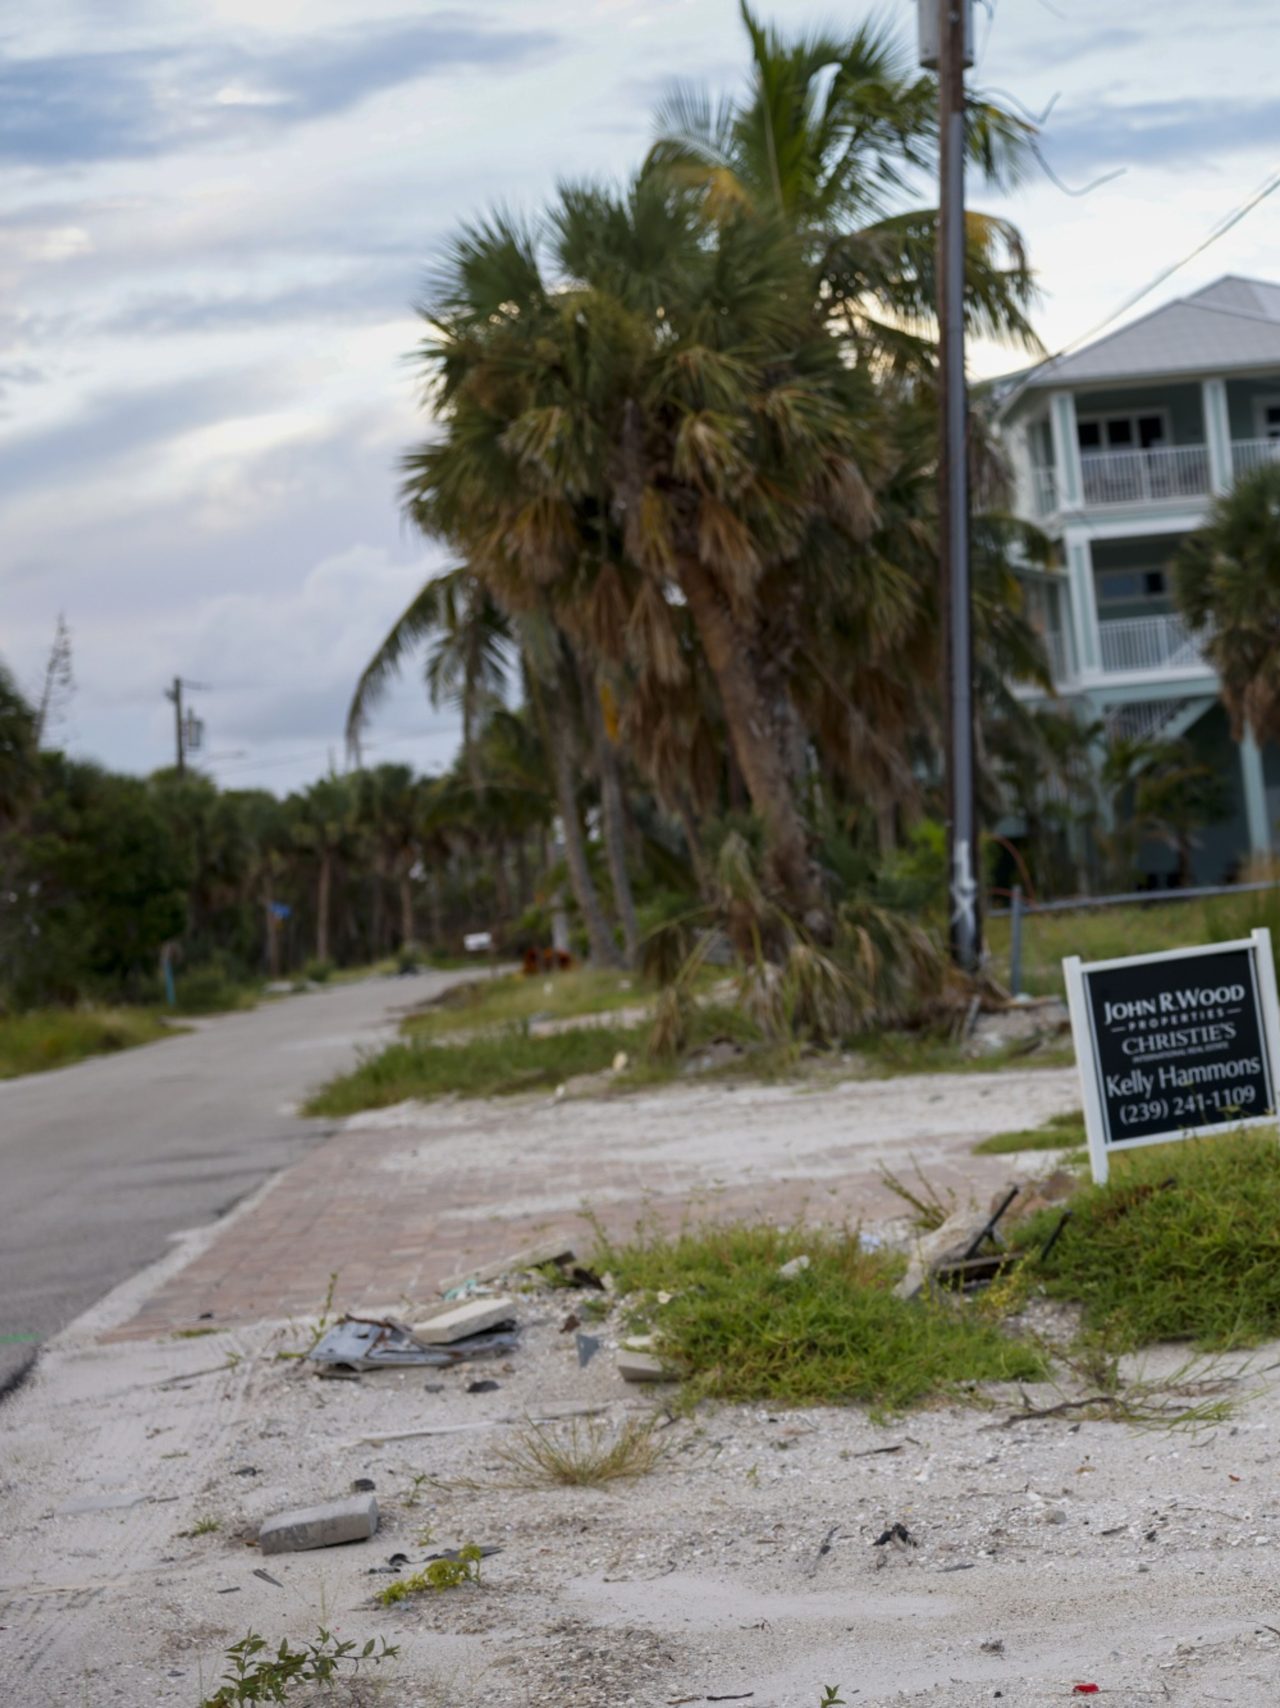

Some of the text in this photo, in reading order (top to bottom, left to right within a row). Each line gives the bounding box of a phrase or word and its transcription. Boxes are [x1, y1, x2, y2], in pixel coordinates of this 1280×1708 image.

[1104, 998, 1156, 1025] JOHN
[1128, 1007, 1224, 1032] PROPERTIES
[1121, 1021, 1237, 1055] CHRISTIE'S
[1105, 1056, 1260, 1099] Kelly Hammons
[1119, 1085, 1256, 1125] (239) 241-1109
